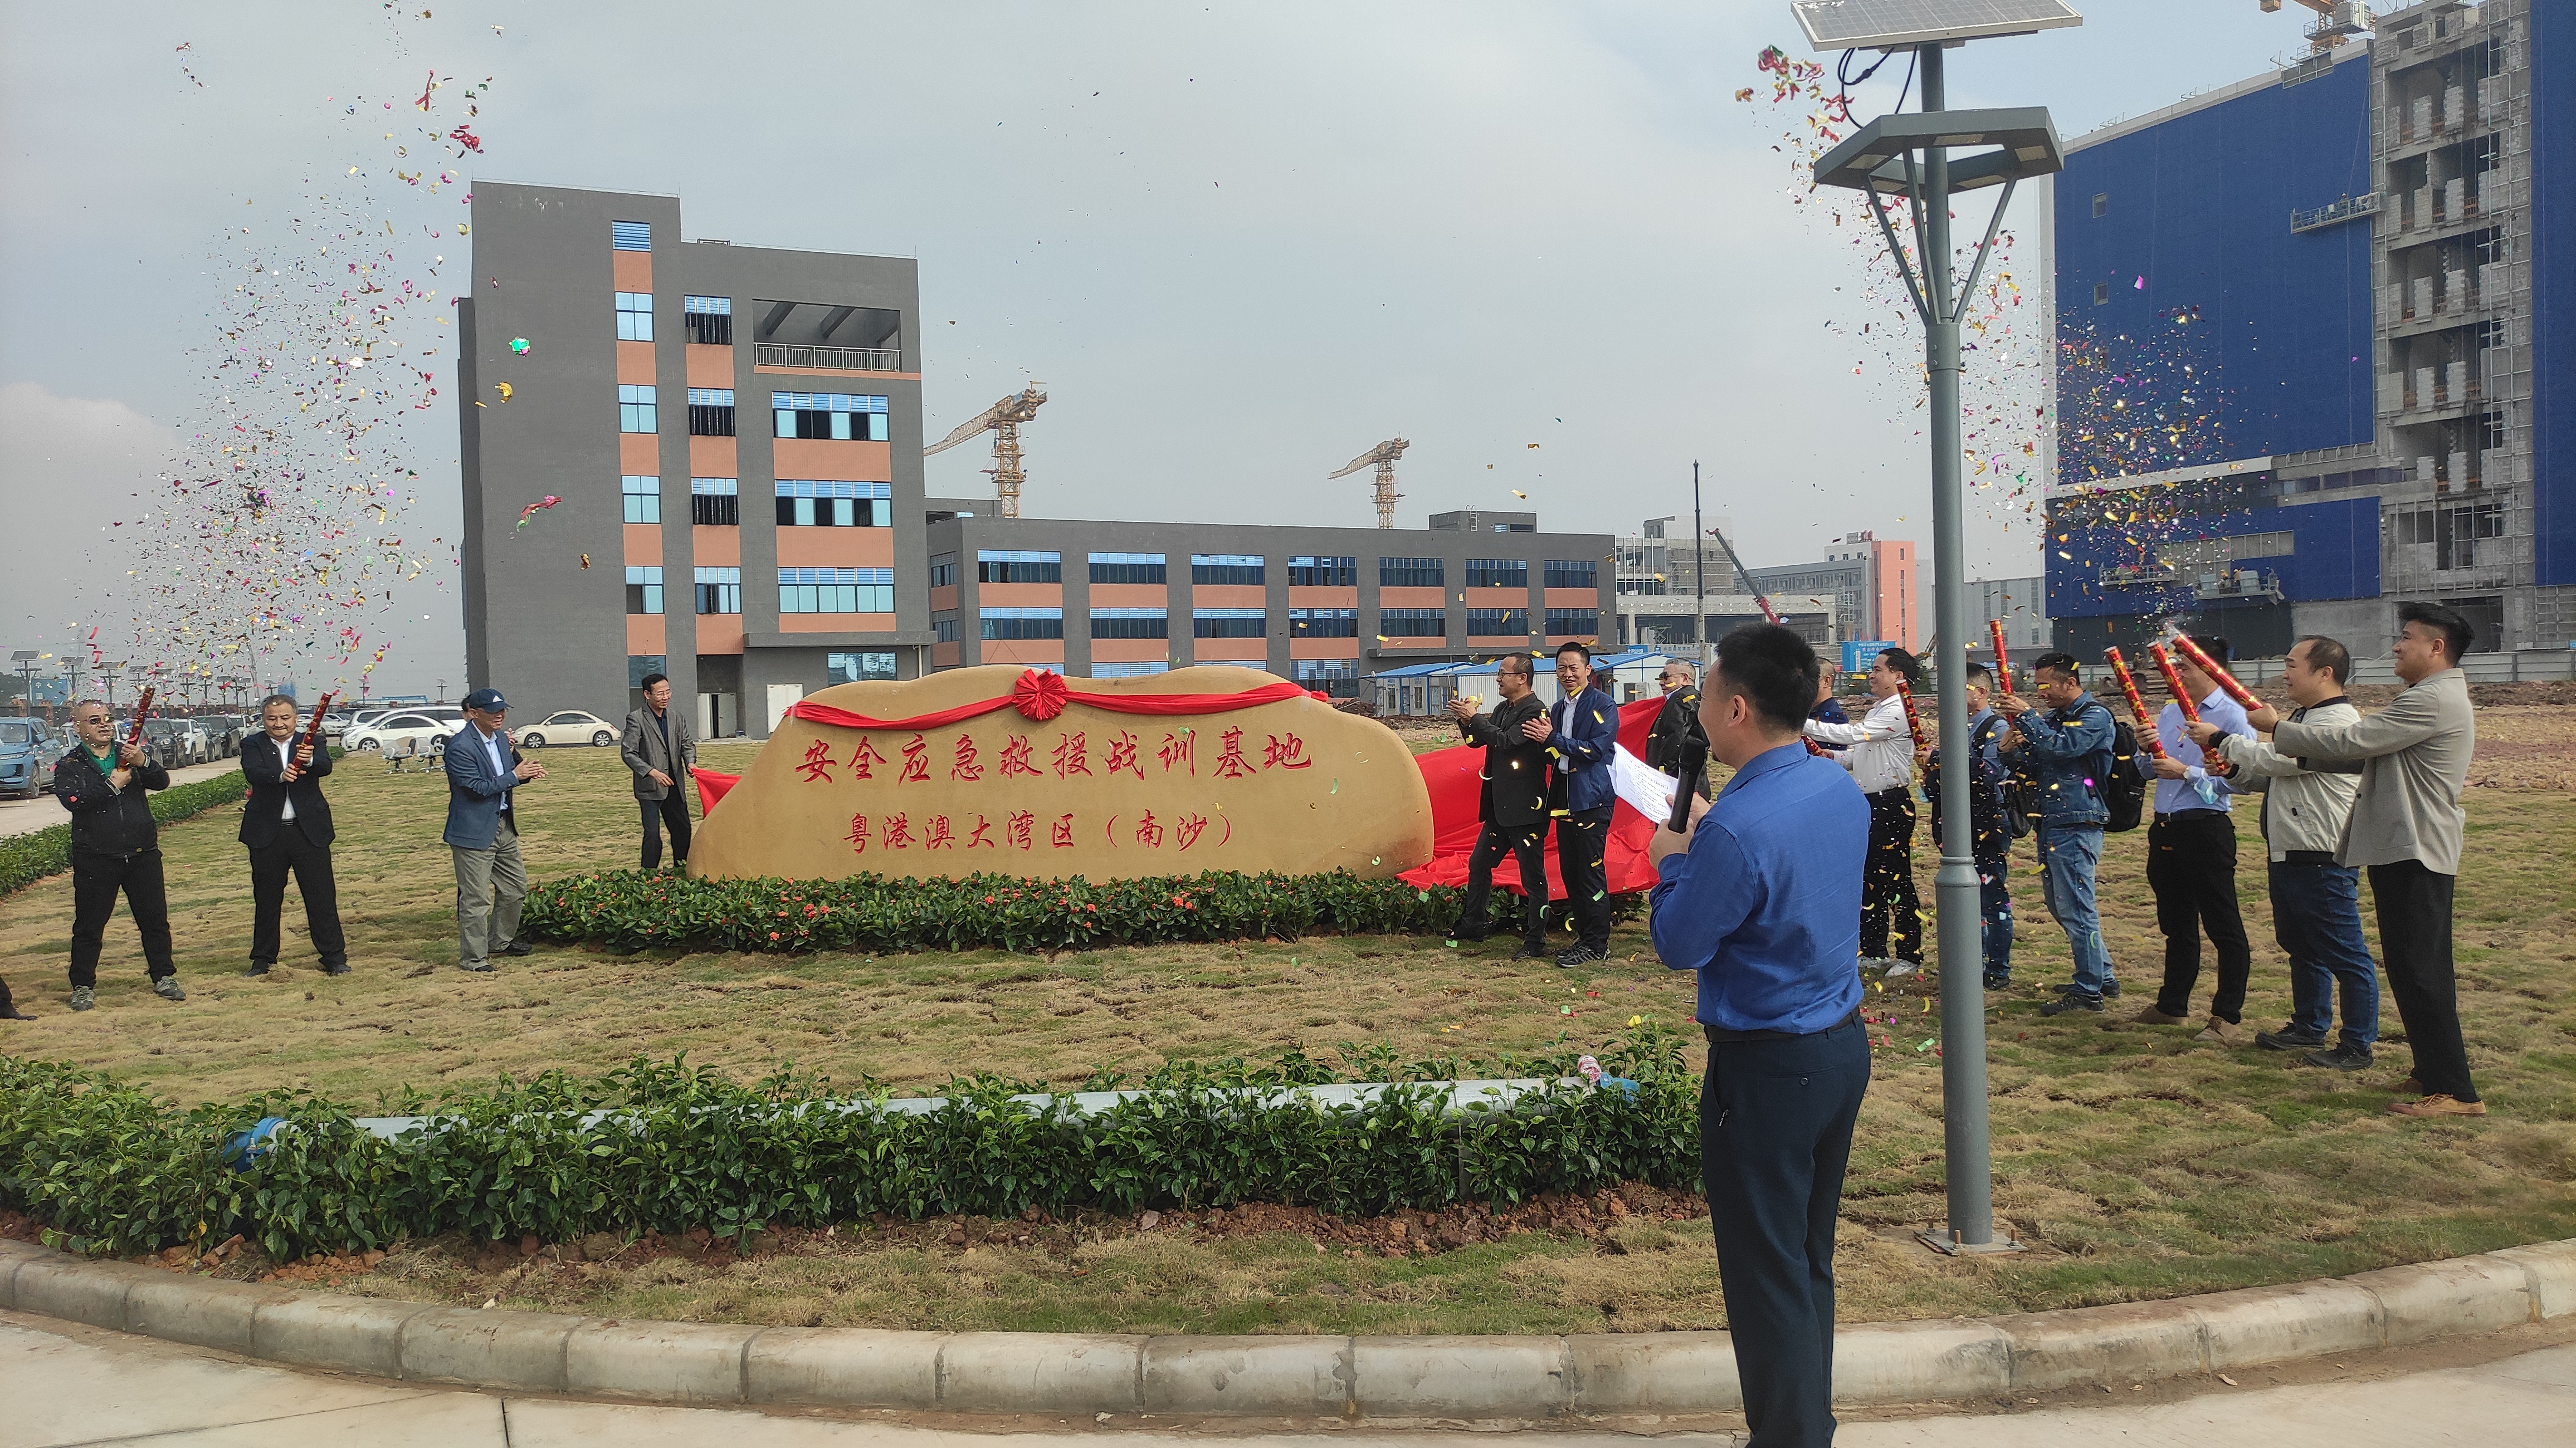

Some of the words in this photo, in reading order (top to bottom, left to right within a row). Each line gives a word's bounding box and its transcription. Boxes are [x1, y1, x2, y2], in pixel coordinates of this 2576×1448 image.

[795, 726, 1312, 785] 安全应急救援战训基地
